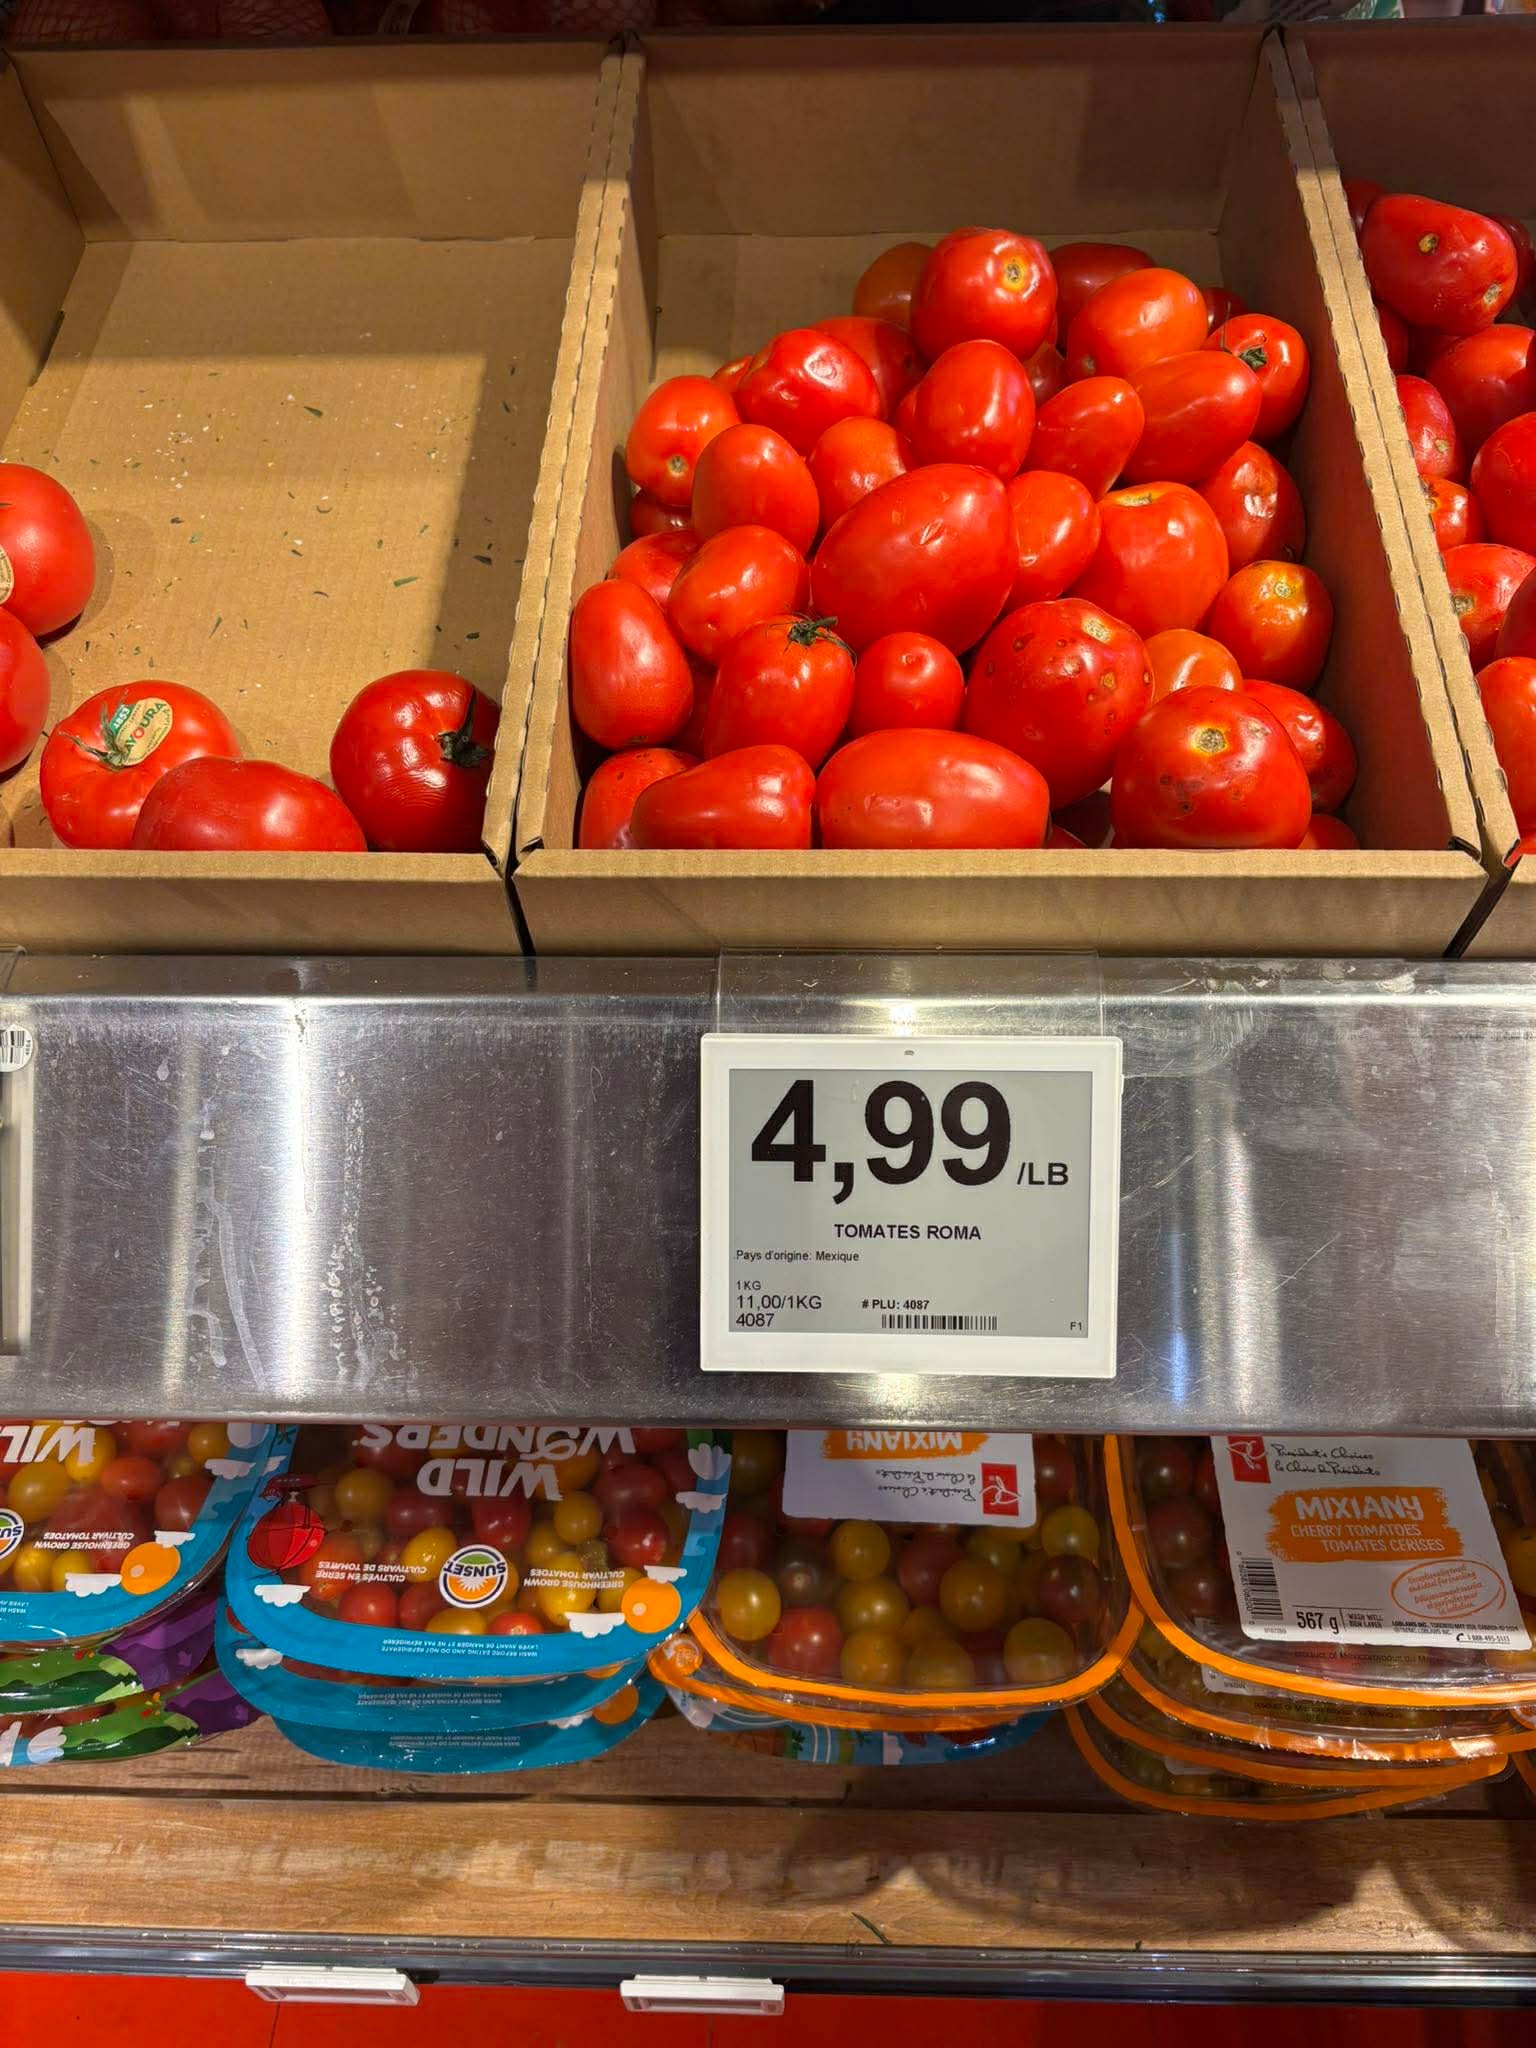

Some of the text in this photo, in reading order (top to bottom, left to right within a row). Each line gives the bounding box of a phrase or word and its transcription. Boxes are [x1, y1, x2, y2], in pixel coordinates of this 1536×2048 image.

[123, 702, 166, 754] AVOURA
[752, 1079, 1069, 1204] 4,99 /LB
[834, 1224, 981, 1240] TOMATES ROMA
[736, 1250, 859, 1263] Pays d'origine: Mexique
[737, 1295, 822, 1311] 11,00/1KG
[872, 1300, 900, 1309] PLU:
[903, 1300, 930, 1310] 4087
[736, 1313, 775, 1327] 4087
[1070, 1322, 1082, 1331] F1
[0, 1426, 97, 1466] WIL
[417, 1458, 563, 1501] WILD
[0, 1526, 22, 1538] SU
[43, 1532, 135, 1540] CULTIVAR TOMATOES
[1290, 1523, 1422, 1537] CHERRY TOMATOES
[34, 1541, 130, 1550] GREENHOUSE GROWN
[1320, 1538, 1445, 1552] TOMATES CERISES
[318, 1561, 427, 1574] CULTIVARS DE TOMATES
[443, 1561, 506, 1578] SUNSET
[530, 1568, 625, 1580] CULTIVAR TOMATOES
[315, 1570, 406, 1583] CULTIVÉS EN SERRE
[523, 1578, 624, 1589] GREENHOUSE GROWN
[1296, 1611, 1339, 1634] 567 g
